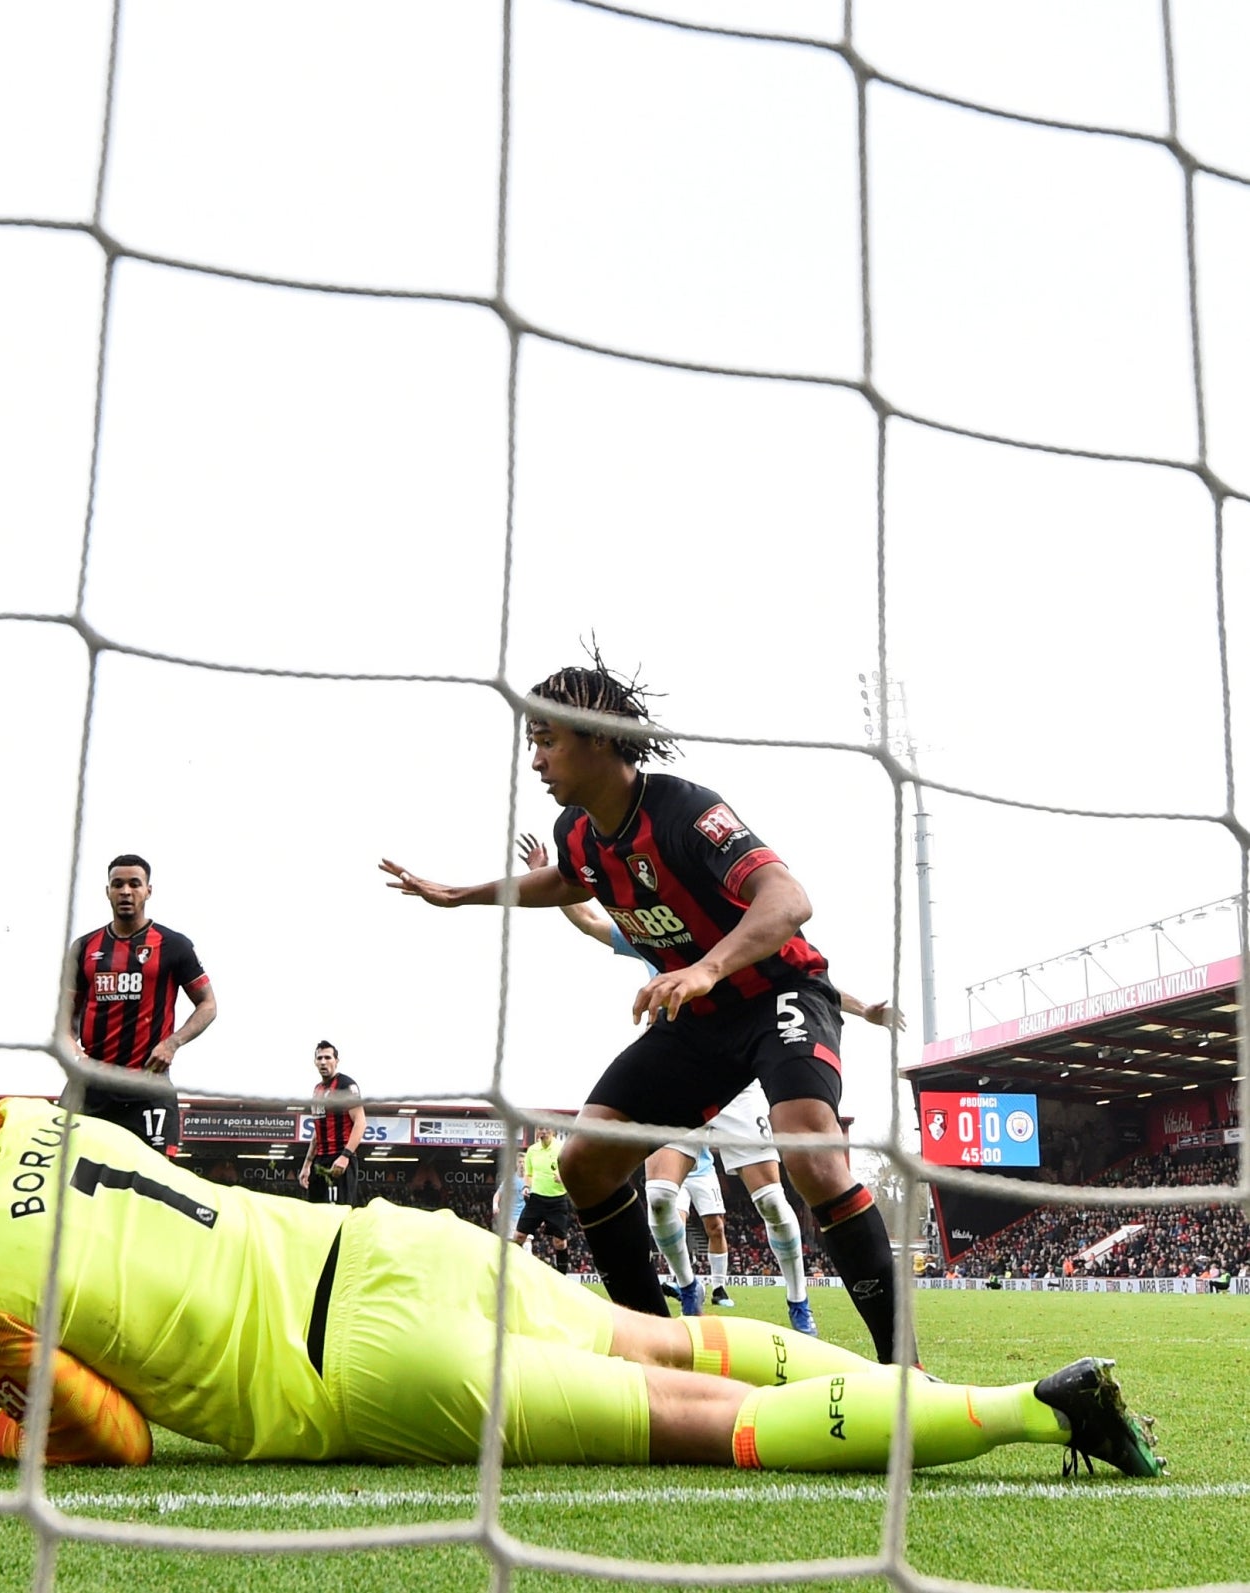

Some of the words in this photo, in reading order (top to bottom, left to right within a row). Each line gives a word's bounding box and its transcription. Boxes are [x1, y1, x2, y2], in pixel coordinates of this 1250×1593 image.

[777, 991, 805, 1030] 5
[1018, 1013, 1048, 1035] HEALTH
[1049, 1007, 1066, 1028] AND
[1068, 1002, 1084, 1023] LIFE
[1085, 989, 1137, 1018] INSURANCE
[1138, 980, 1164, 1002] WITH
[1164, 966, 1209, 997] VITALITY
[959, 1097, 998, 1108] #BOUMCI
[142, 1108, 167, 1137] 17
[184, 1117, 221, 1127] premier
[223, 1118, 252, 1127] sports
[254, 1117, 295, 1126] solutions
[958, 1111, 974, 1143] 0
[985, 1112, 1001, 1143] 0
[10, 1114, 81, 1219] BORUC
[961, 1147, 1002, 1163] 45:00
[69, 1156, 219, 1230] 1
[327, 1186, 338, 1202] 11
[829, 1377, 846, 1441] AFCB
